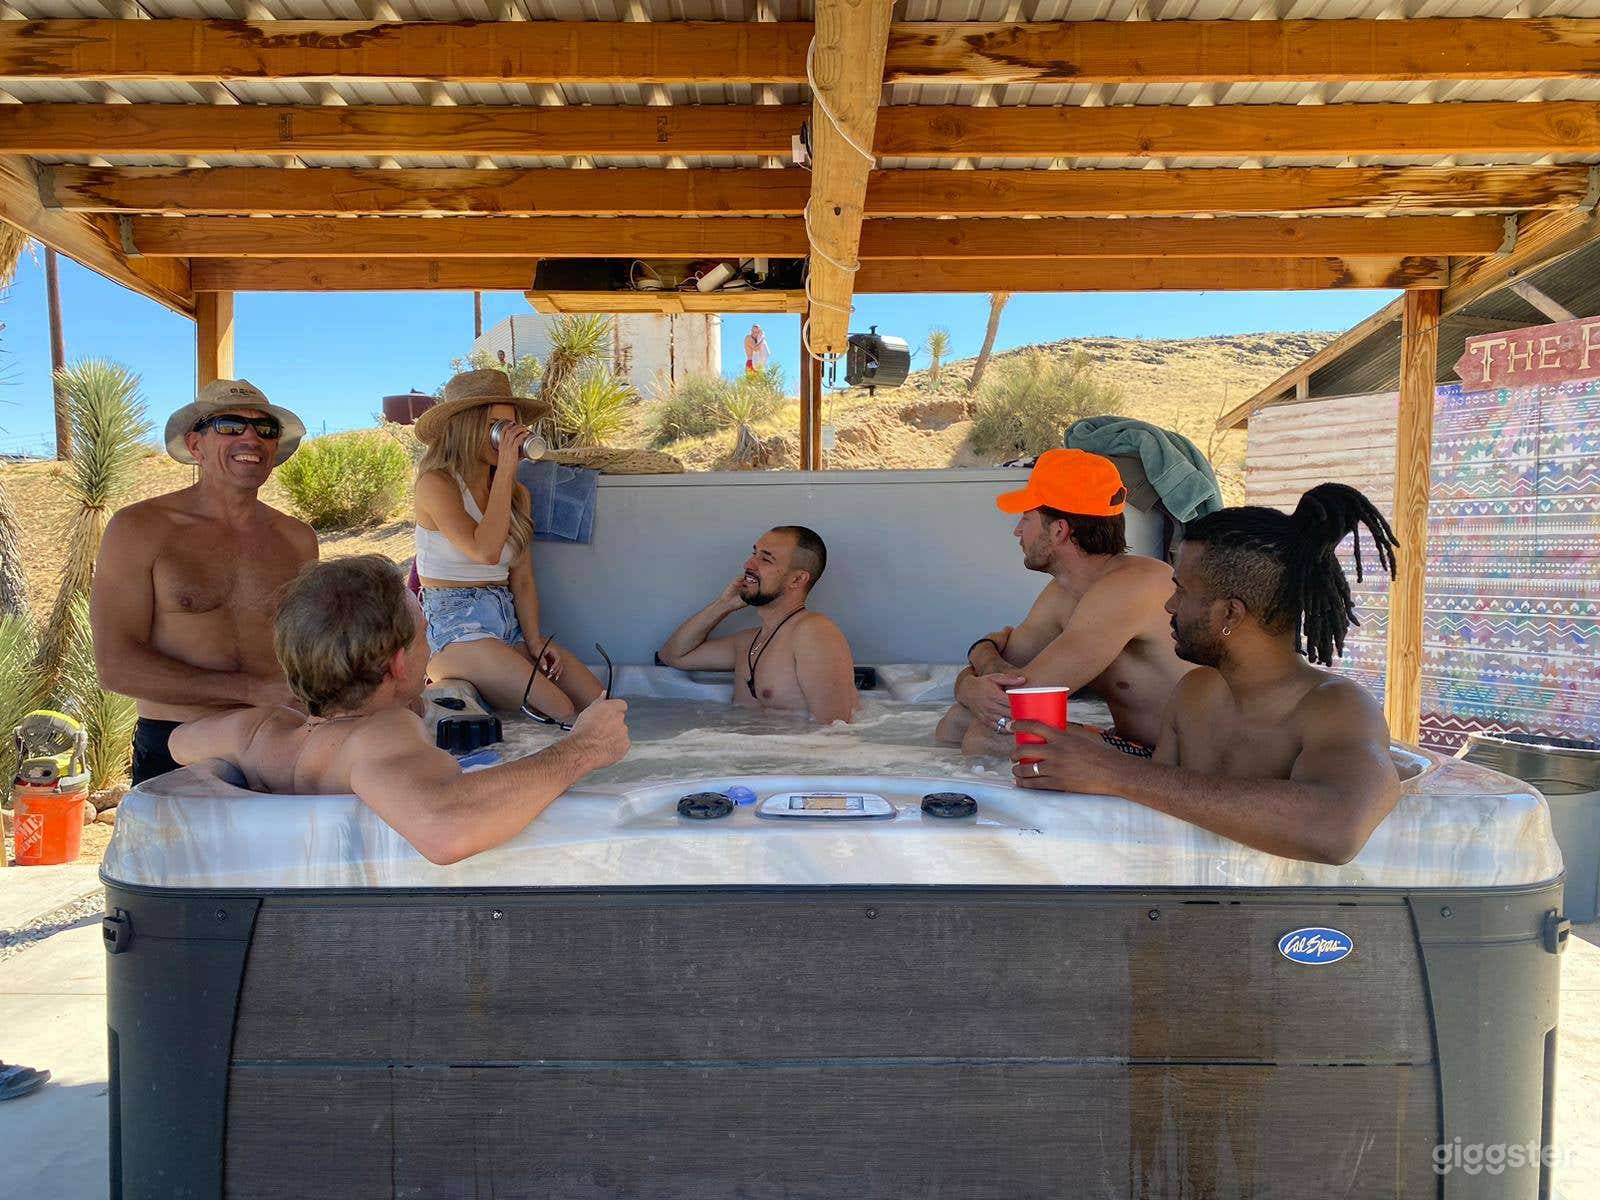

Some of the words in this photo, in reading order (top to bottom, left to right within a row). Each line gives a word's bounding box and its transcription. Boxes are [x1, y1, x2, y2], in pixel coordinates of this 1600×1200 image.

[1470, 335, 1562, 383] THE
[1283, 935, 1307, 954] Cal
[1305, 934, 1347, 957] Spas
